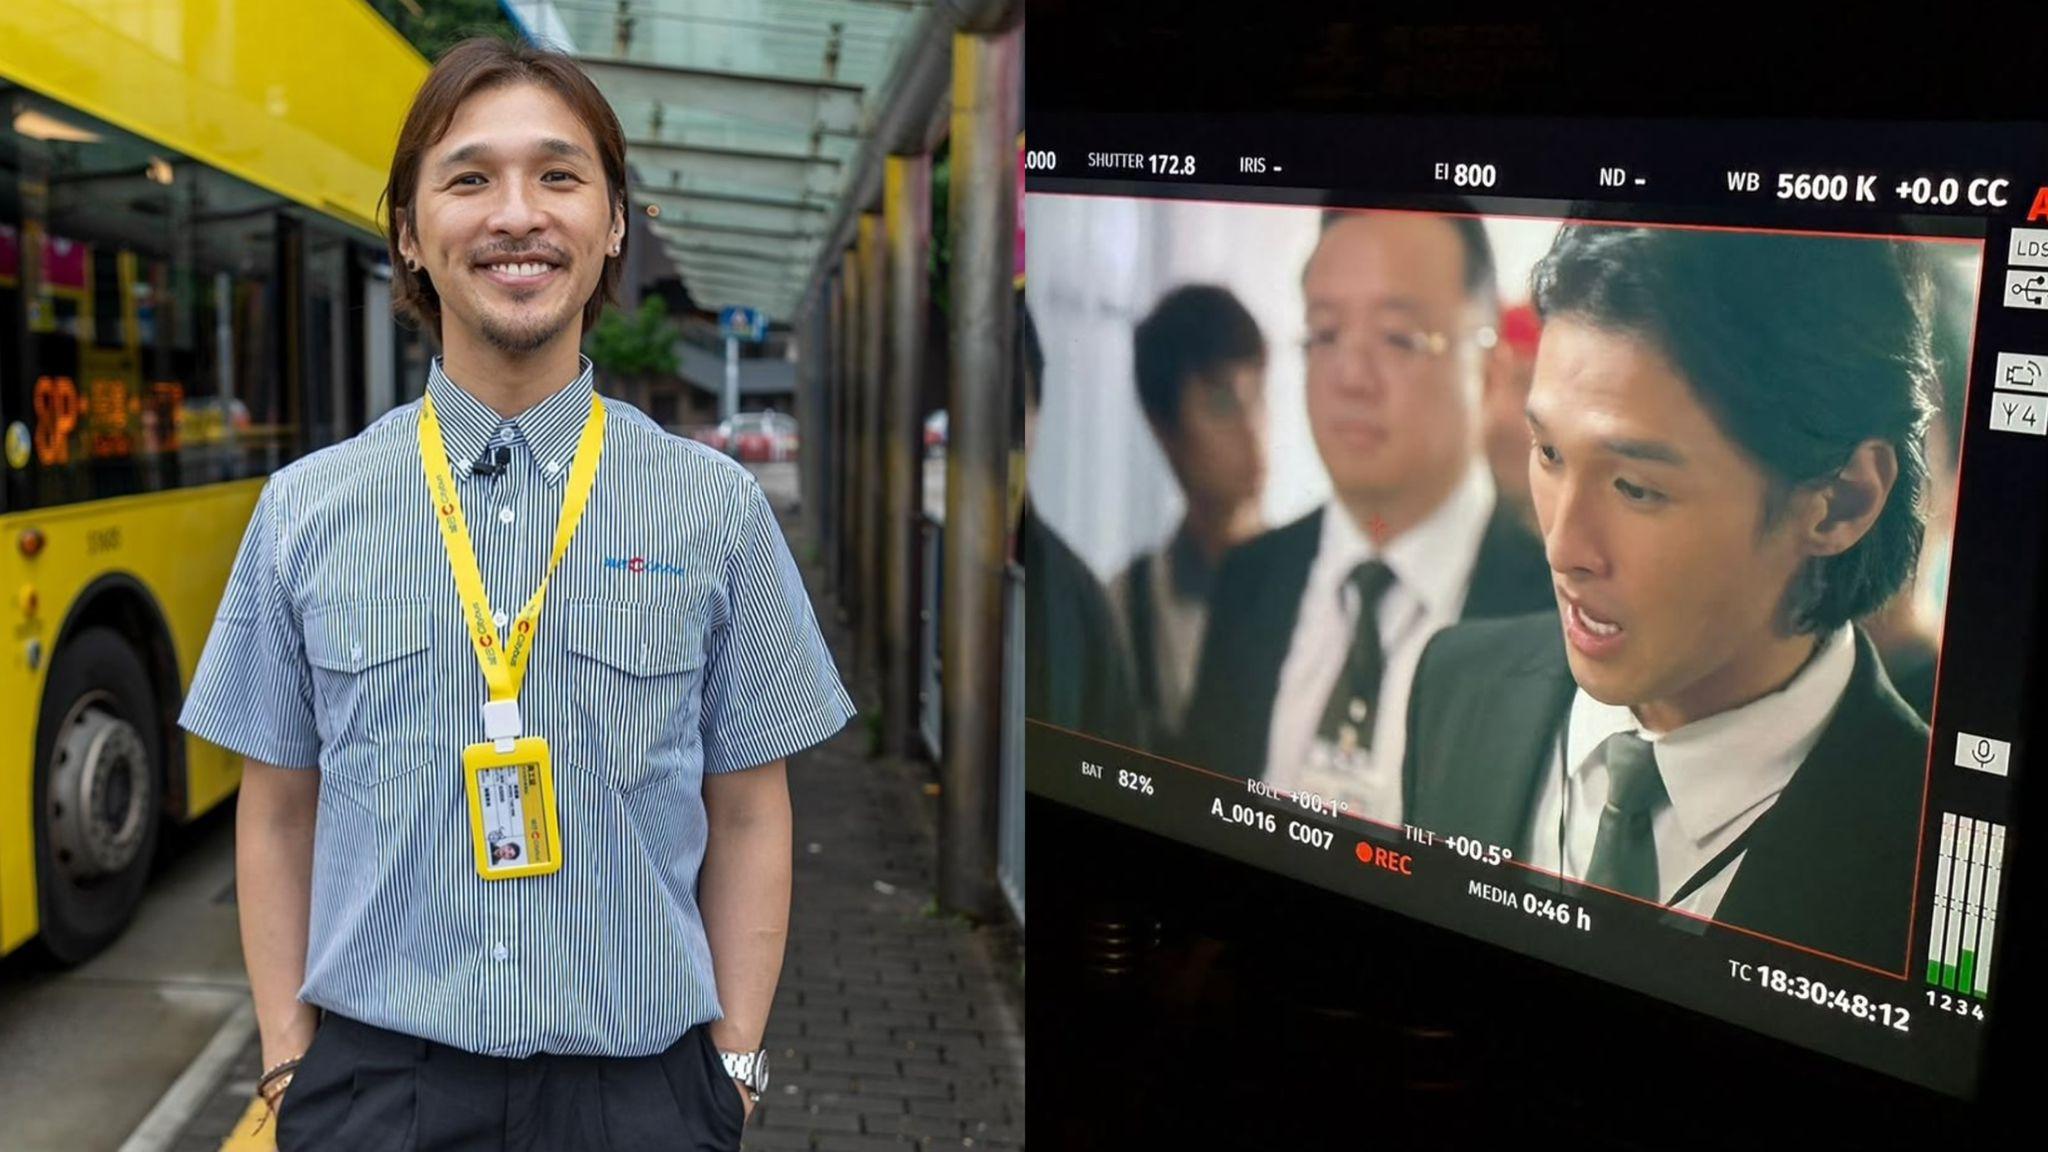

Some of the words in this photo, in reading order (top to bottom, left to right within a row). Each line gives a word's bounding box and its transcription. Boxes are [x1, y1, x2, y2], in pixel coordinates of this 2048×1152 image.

[1088, 152, 1144, 169] SHUTTER
[1148, 154, 1196, 176] 172.8
[1240, 156, 1266, 173] IRIS
[1434, 162, 1449, 180] EI
[1453, 163, 1497, 188] 800
[1599, 167, 1626, 187] ND
[1727, 171, 1760, 192] WB
[1776, 173, 1848, 202] 5600
[1855, 174, 1878, 202] K
[1895, 177, 1959, 206] +0.0
[1967, 178, 2009, 207] CC
[1081, 761, 1103, 779] BAT
[1118, 769, 1154, 796] 82%
[1247, 778, 1281, 801] ROLL
[1211, 797, 1277, 833] A_0016
[1288, 820, 1334, 851] C007
[1404, 823, 1436, 846] TILT
[1374, 847, 1412, 875] REC
[1468, 879, 1518, 909] MEDIA
[1522, 892, 1571, 925] 0:46
[1576, 909, 1591, 932] h
[1728, 959, 1752, 982] TC
[1756, 965, 1911, 1032] 18:30:48:12
